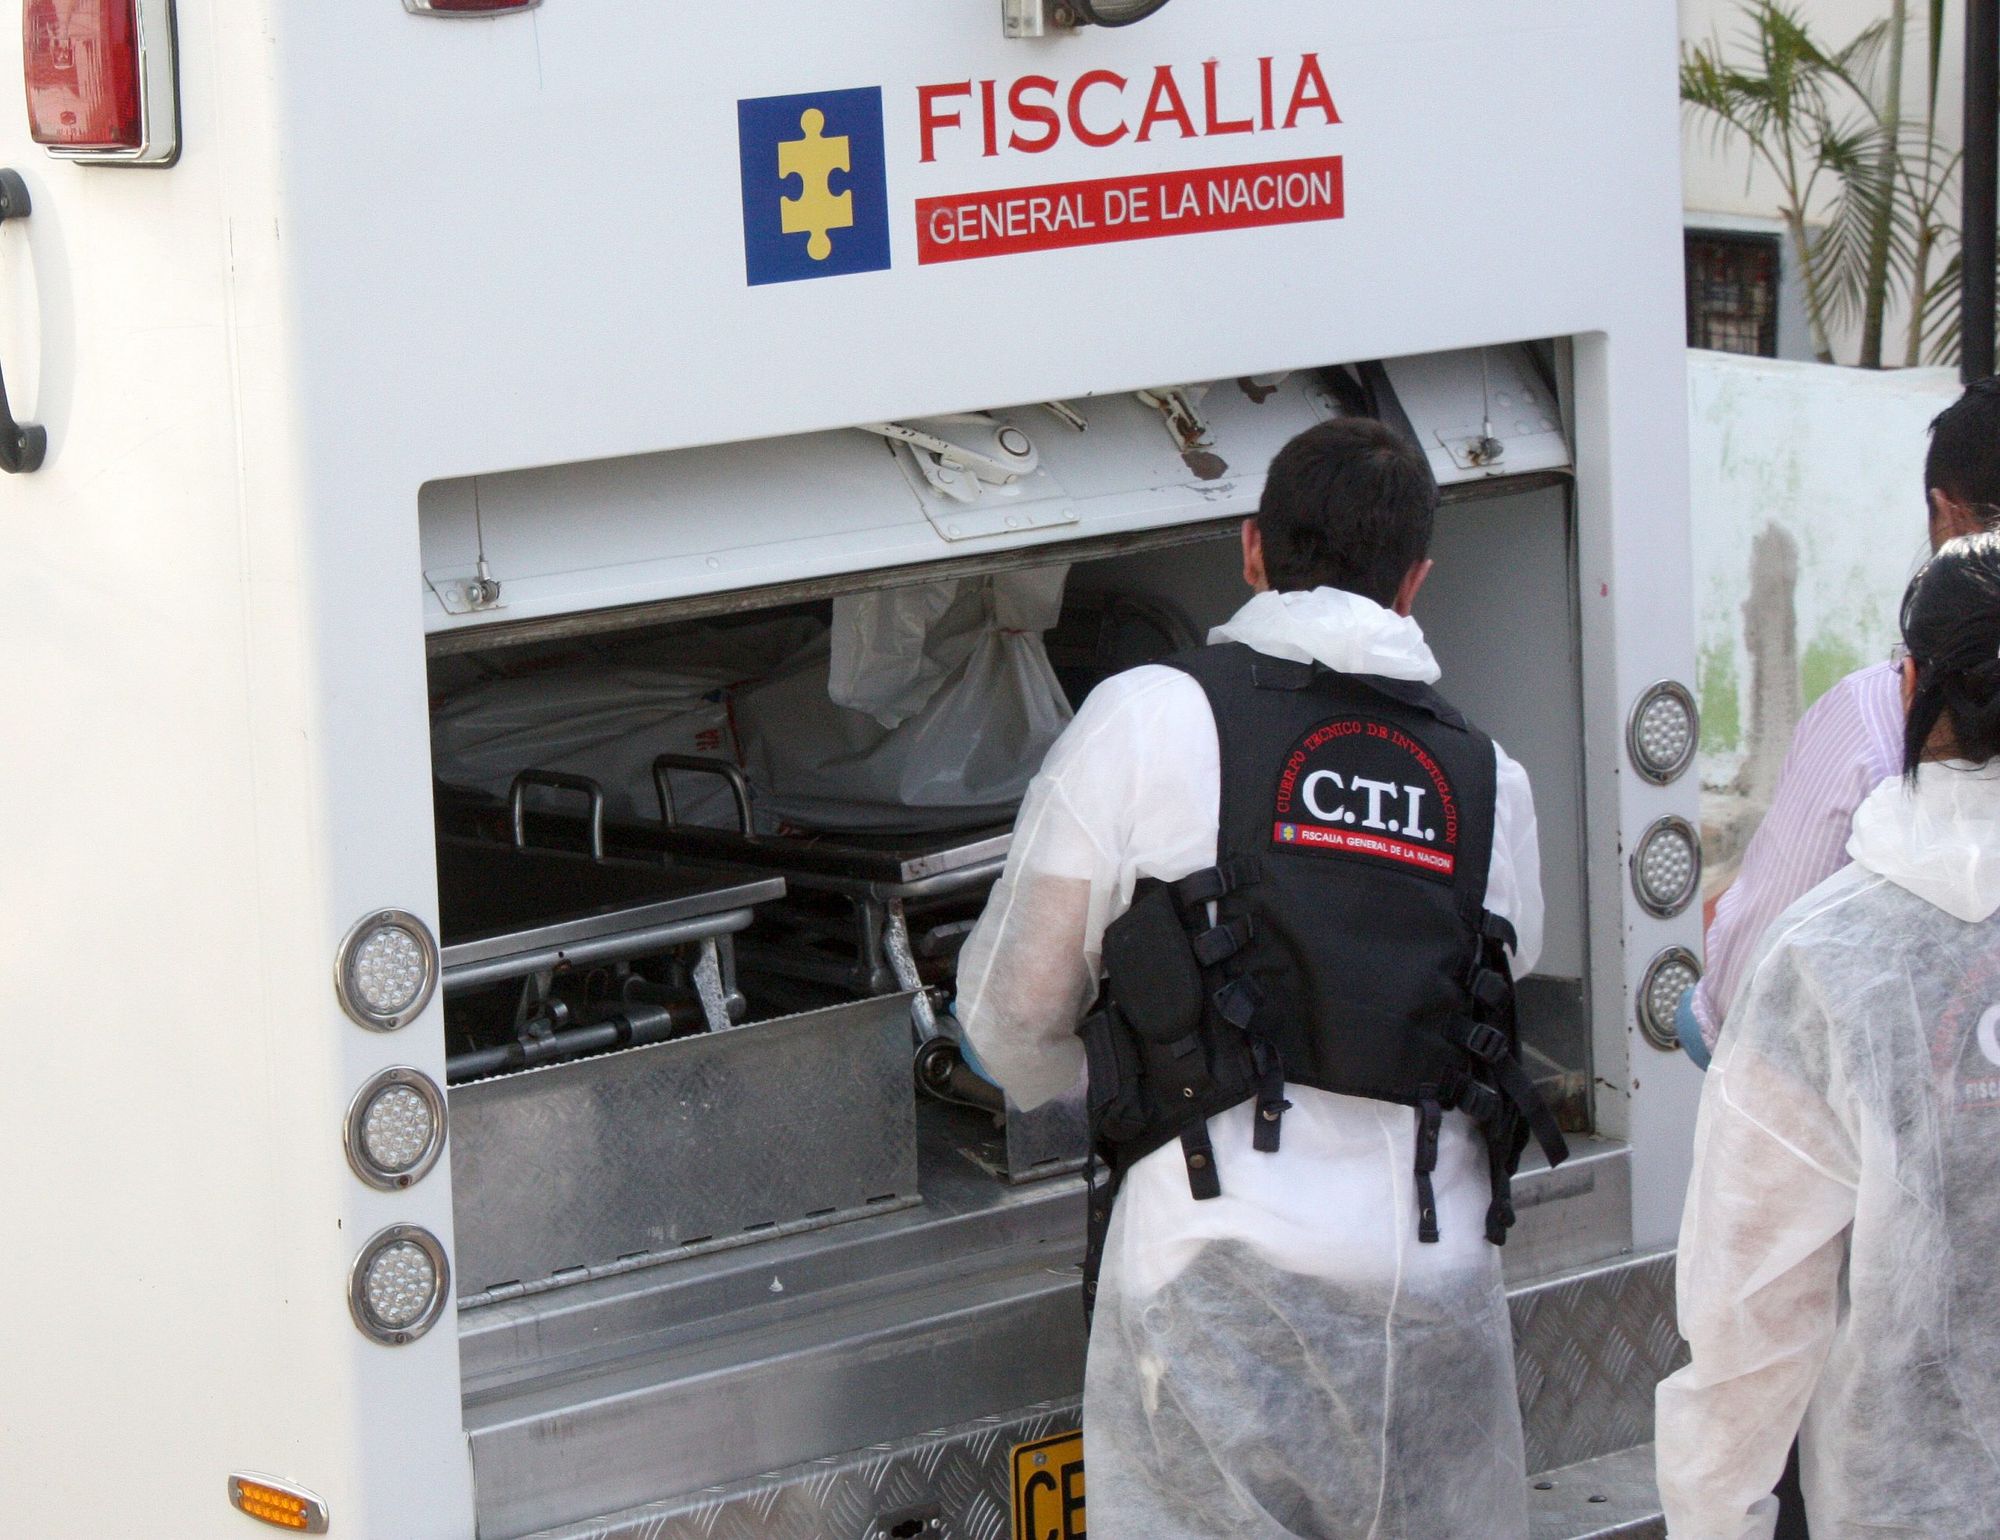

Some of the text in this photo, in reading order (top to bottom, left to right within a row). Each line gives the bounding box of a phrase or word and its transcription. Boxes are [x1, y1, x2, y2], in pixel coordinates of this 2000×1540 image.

[916, 53, 1343, 163] FISCALIA
[929, 171, 1331, 245] GENERAL DE LA NACION
[1276, 721, 1457, 845] CUERPO TECNICO DE INVESTIGACION
[1302, 769, 1436, 842] C.T.I.
[1301, 830, 1451, 869] FISCALIA GENERAL DE LA NACION
